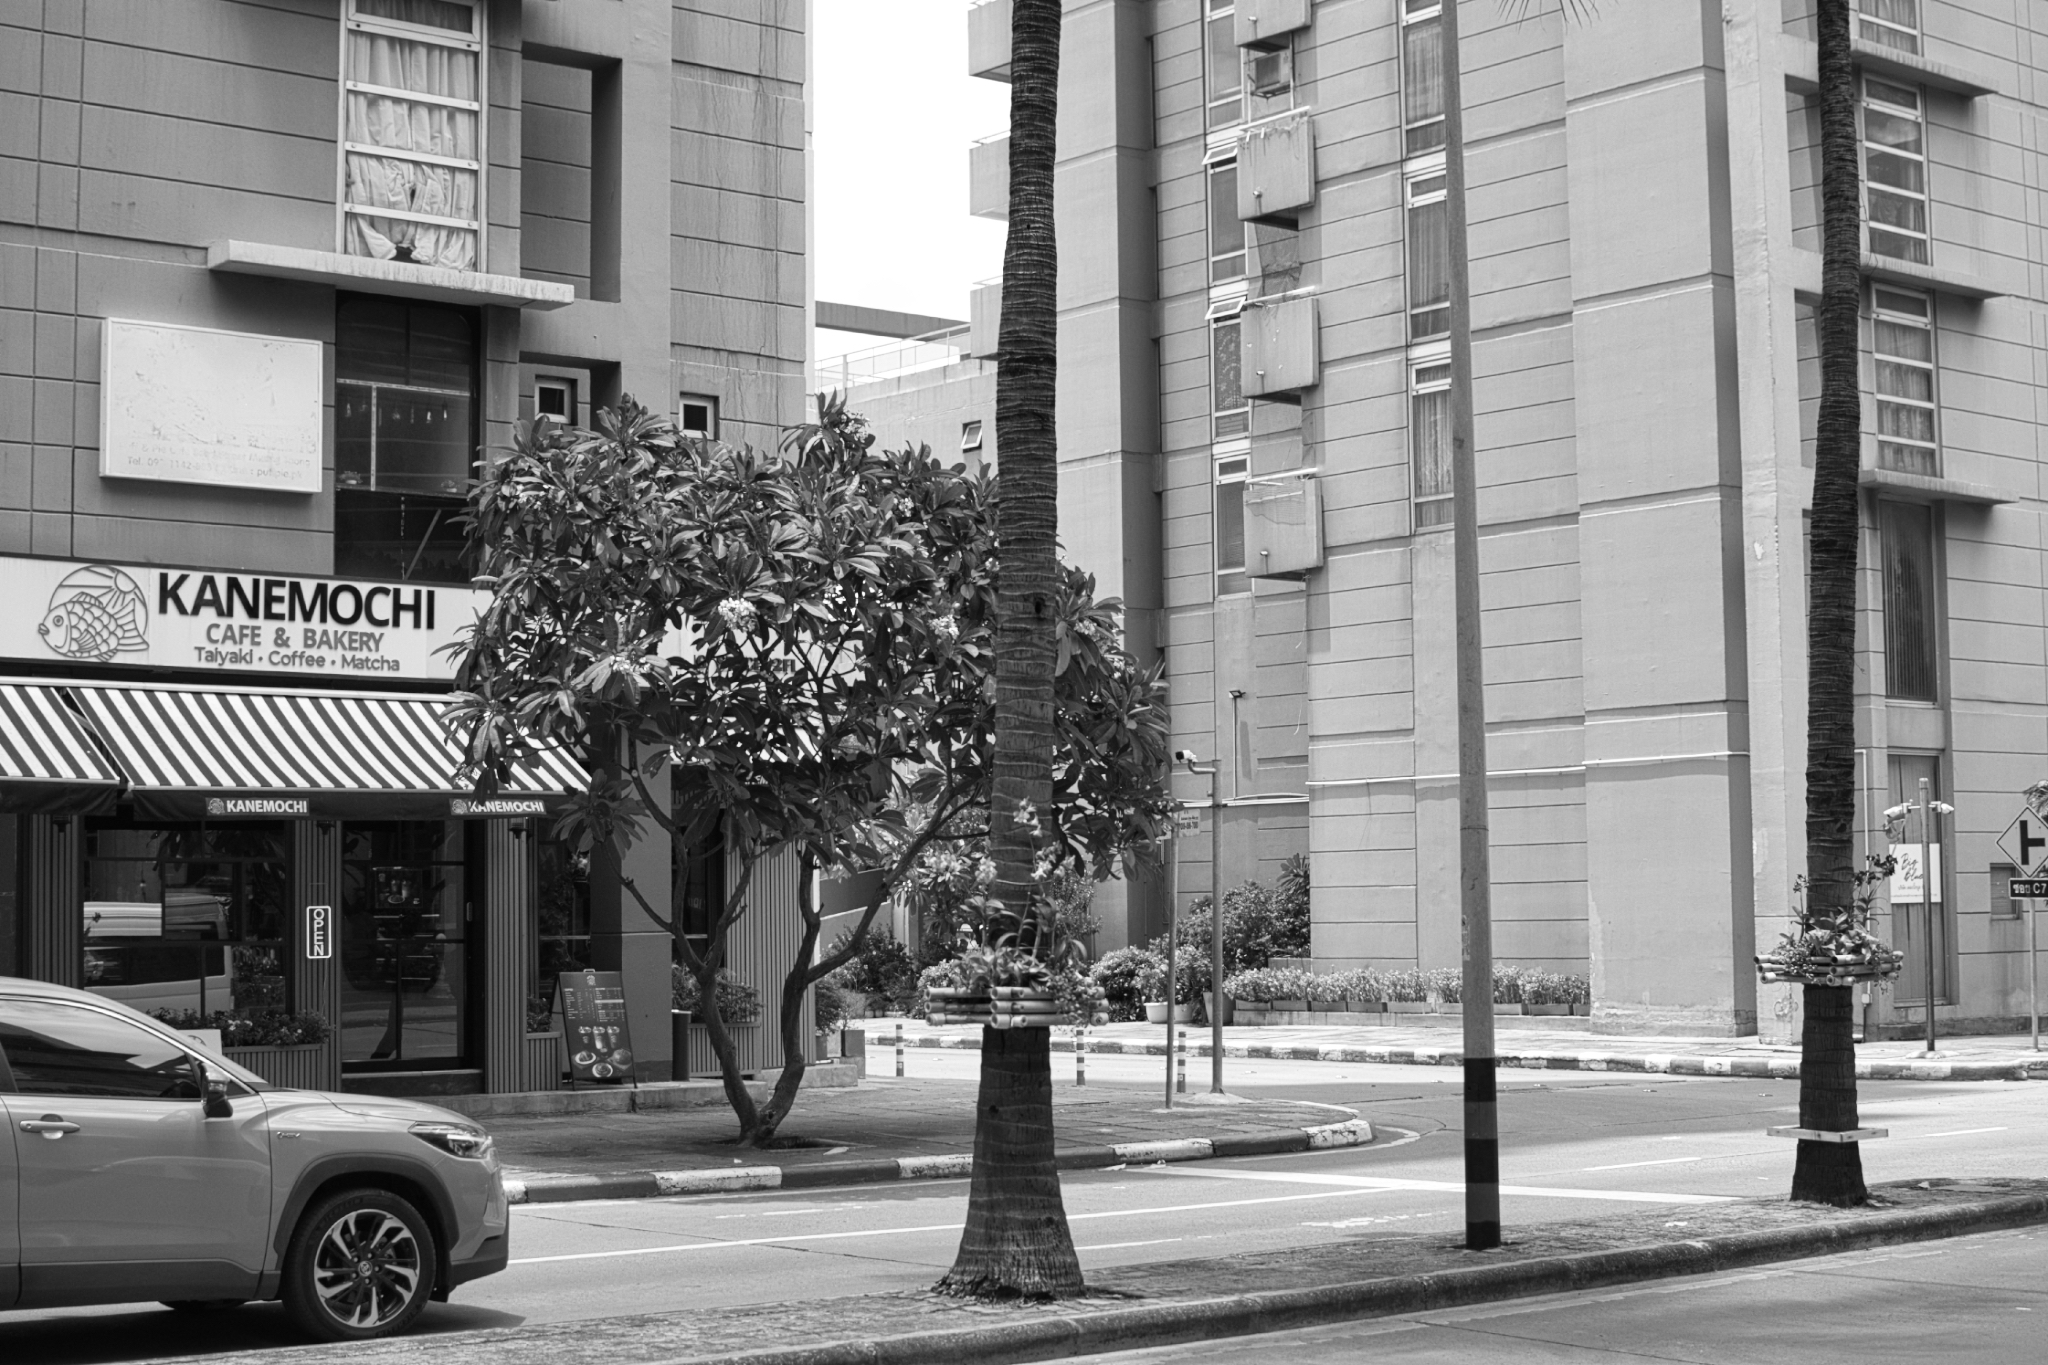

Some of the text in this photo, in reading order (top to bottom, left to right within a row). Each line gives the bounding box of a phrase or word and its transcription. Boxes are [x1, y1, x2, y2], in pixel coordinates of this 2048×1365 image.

[159, 572, 435, 630] KANEMOCHI
[206, 623, 385, 652] CAFE & BAKERY
[194, 646, 400, 671] Taiyaki Coffee Matcha
[226, 800, 308, 813] KANEMOCHI
[2032, 882, 2047, 894] C7
[313, 908, 325, 956] OPEN
